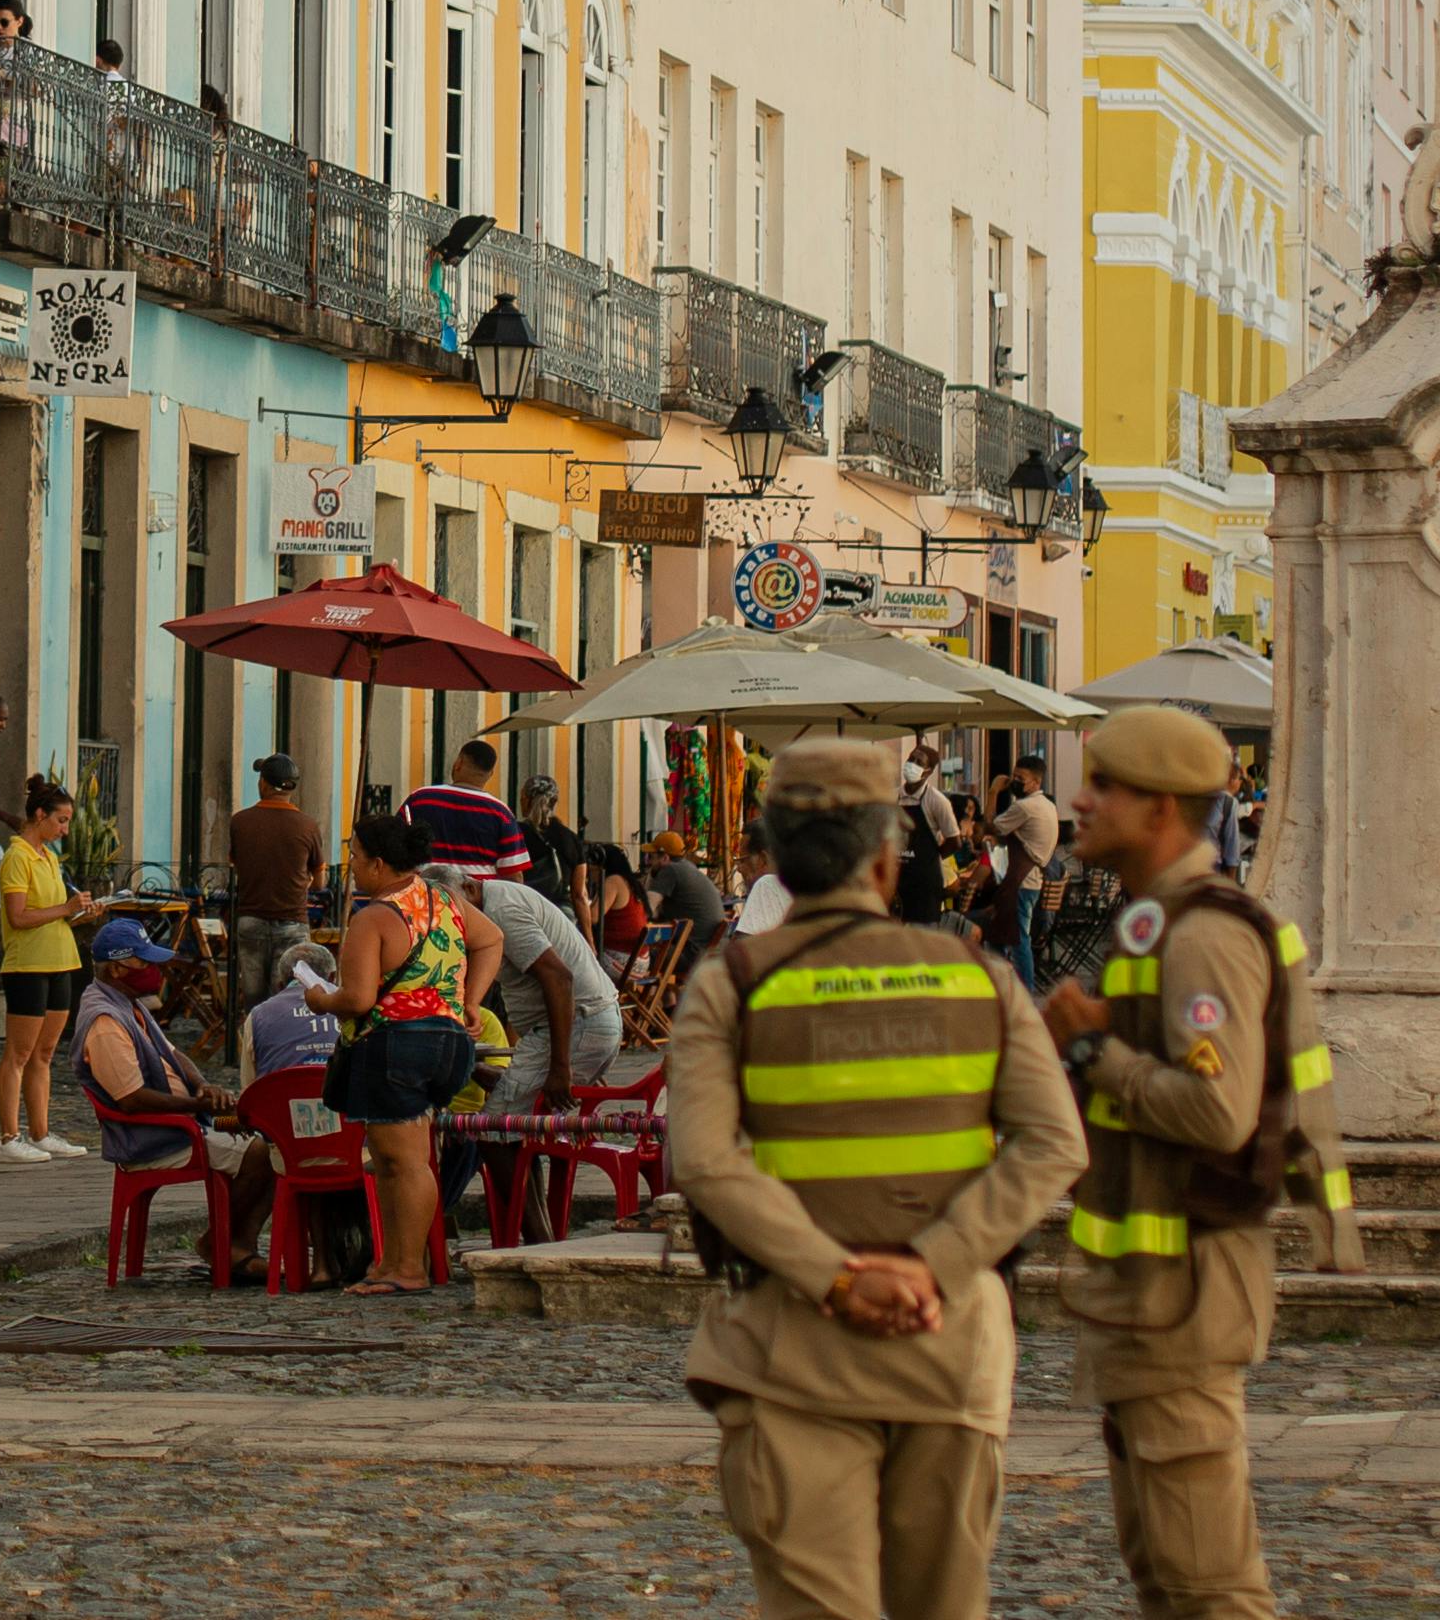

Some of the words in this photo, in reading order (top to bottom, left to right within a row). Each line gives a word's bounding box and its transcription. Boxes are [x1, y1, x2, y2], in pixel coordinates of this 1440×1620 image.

[36, 277, 126, 311] ROMA
[30, 358, 129, 387] NEGRA
[616, 491, 689, 514] BOTECO
[641, 513, 658, 525] DO
[604, 523, 696, 542] PELOURINHO
[276, 541, 326, 552] RESTAURANTE
